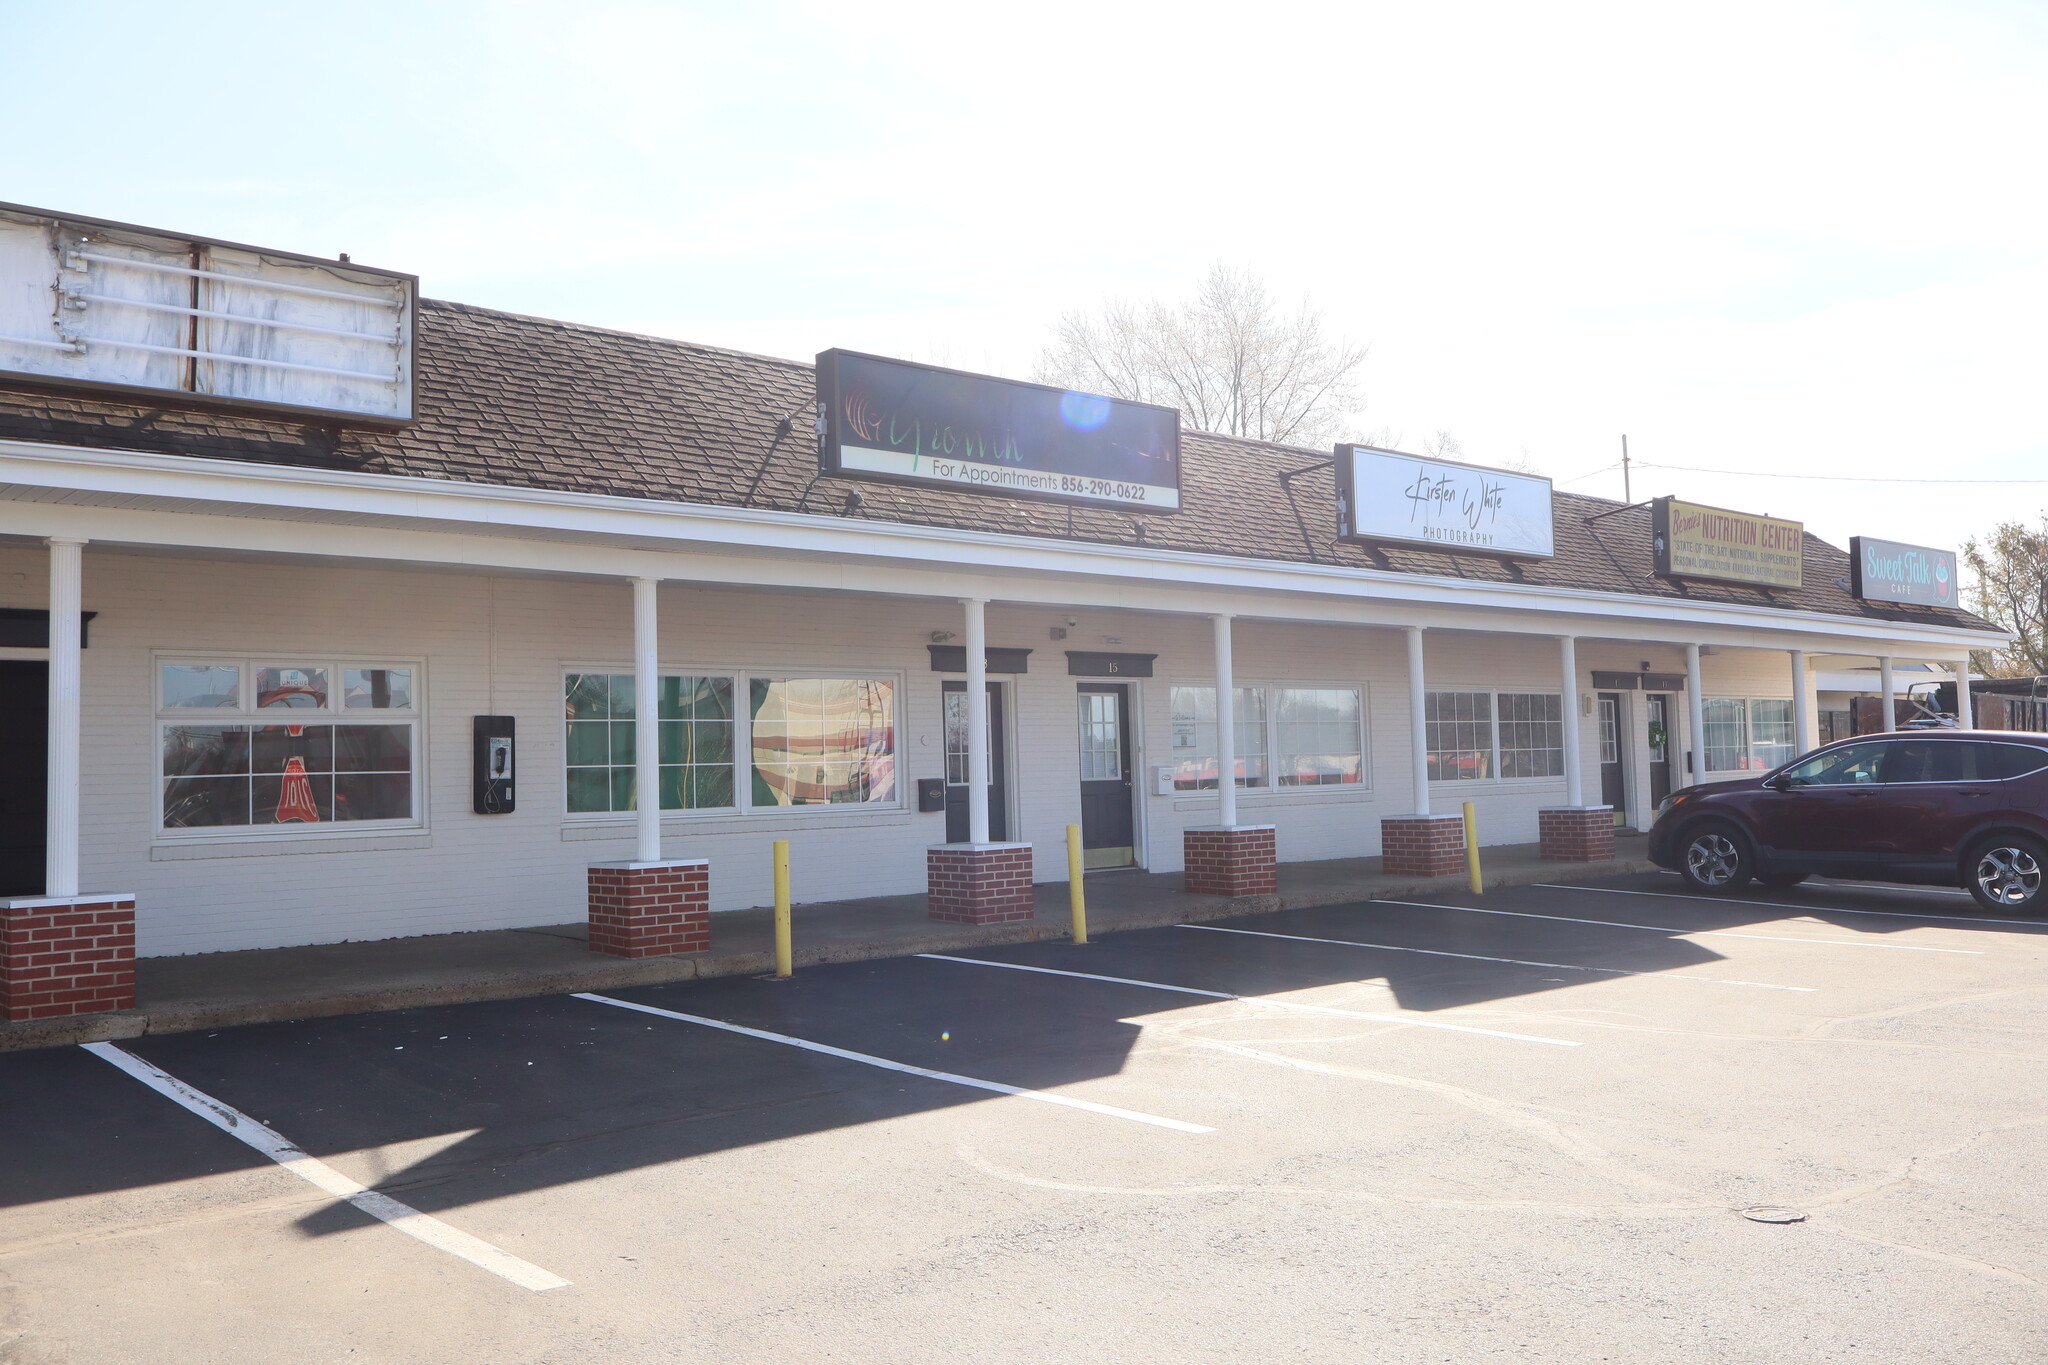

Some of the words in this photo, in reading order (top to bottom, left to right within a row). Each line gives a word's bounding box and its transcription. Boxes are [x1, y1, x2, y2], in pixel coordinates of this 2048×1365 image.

[933, 459, 955, 478] For
[959, 464, 1058, 490] Appointments
[1061, 476, 1145, 500] 856-290-0622
[1404, 465, 1456, 523] Kirsten
[1462, 472, 1507, 530] White
[1423, 526, 1494, 545] PHOTOGRAPHY
[1702, 513, 1757, 546] NUTRITION
[1761, 523, 1799, 552] CENTER
[1695, 542, 1703, 554] OF
[1704, 544, 1715, 557] THE
[1717, 546, 1728, 558] ART
[1867, 545, 1904, 582] Sweet
[1904, 551, 1932, 585] Talk
[1891, 583, 1911, 595] CAFE
[1108, 662, 1118, 673] 15
